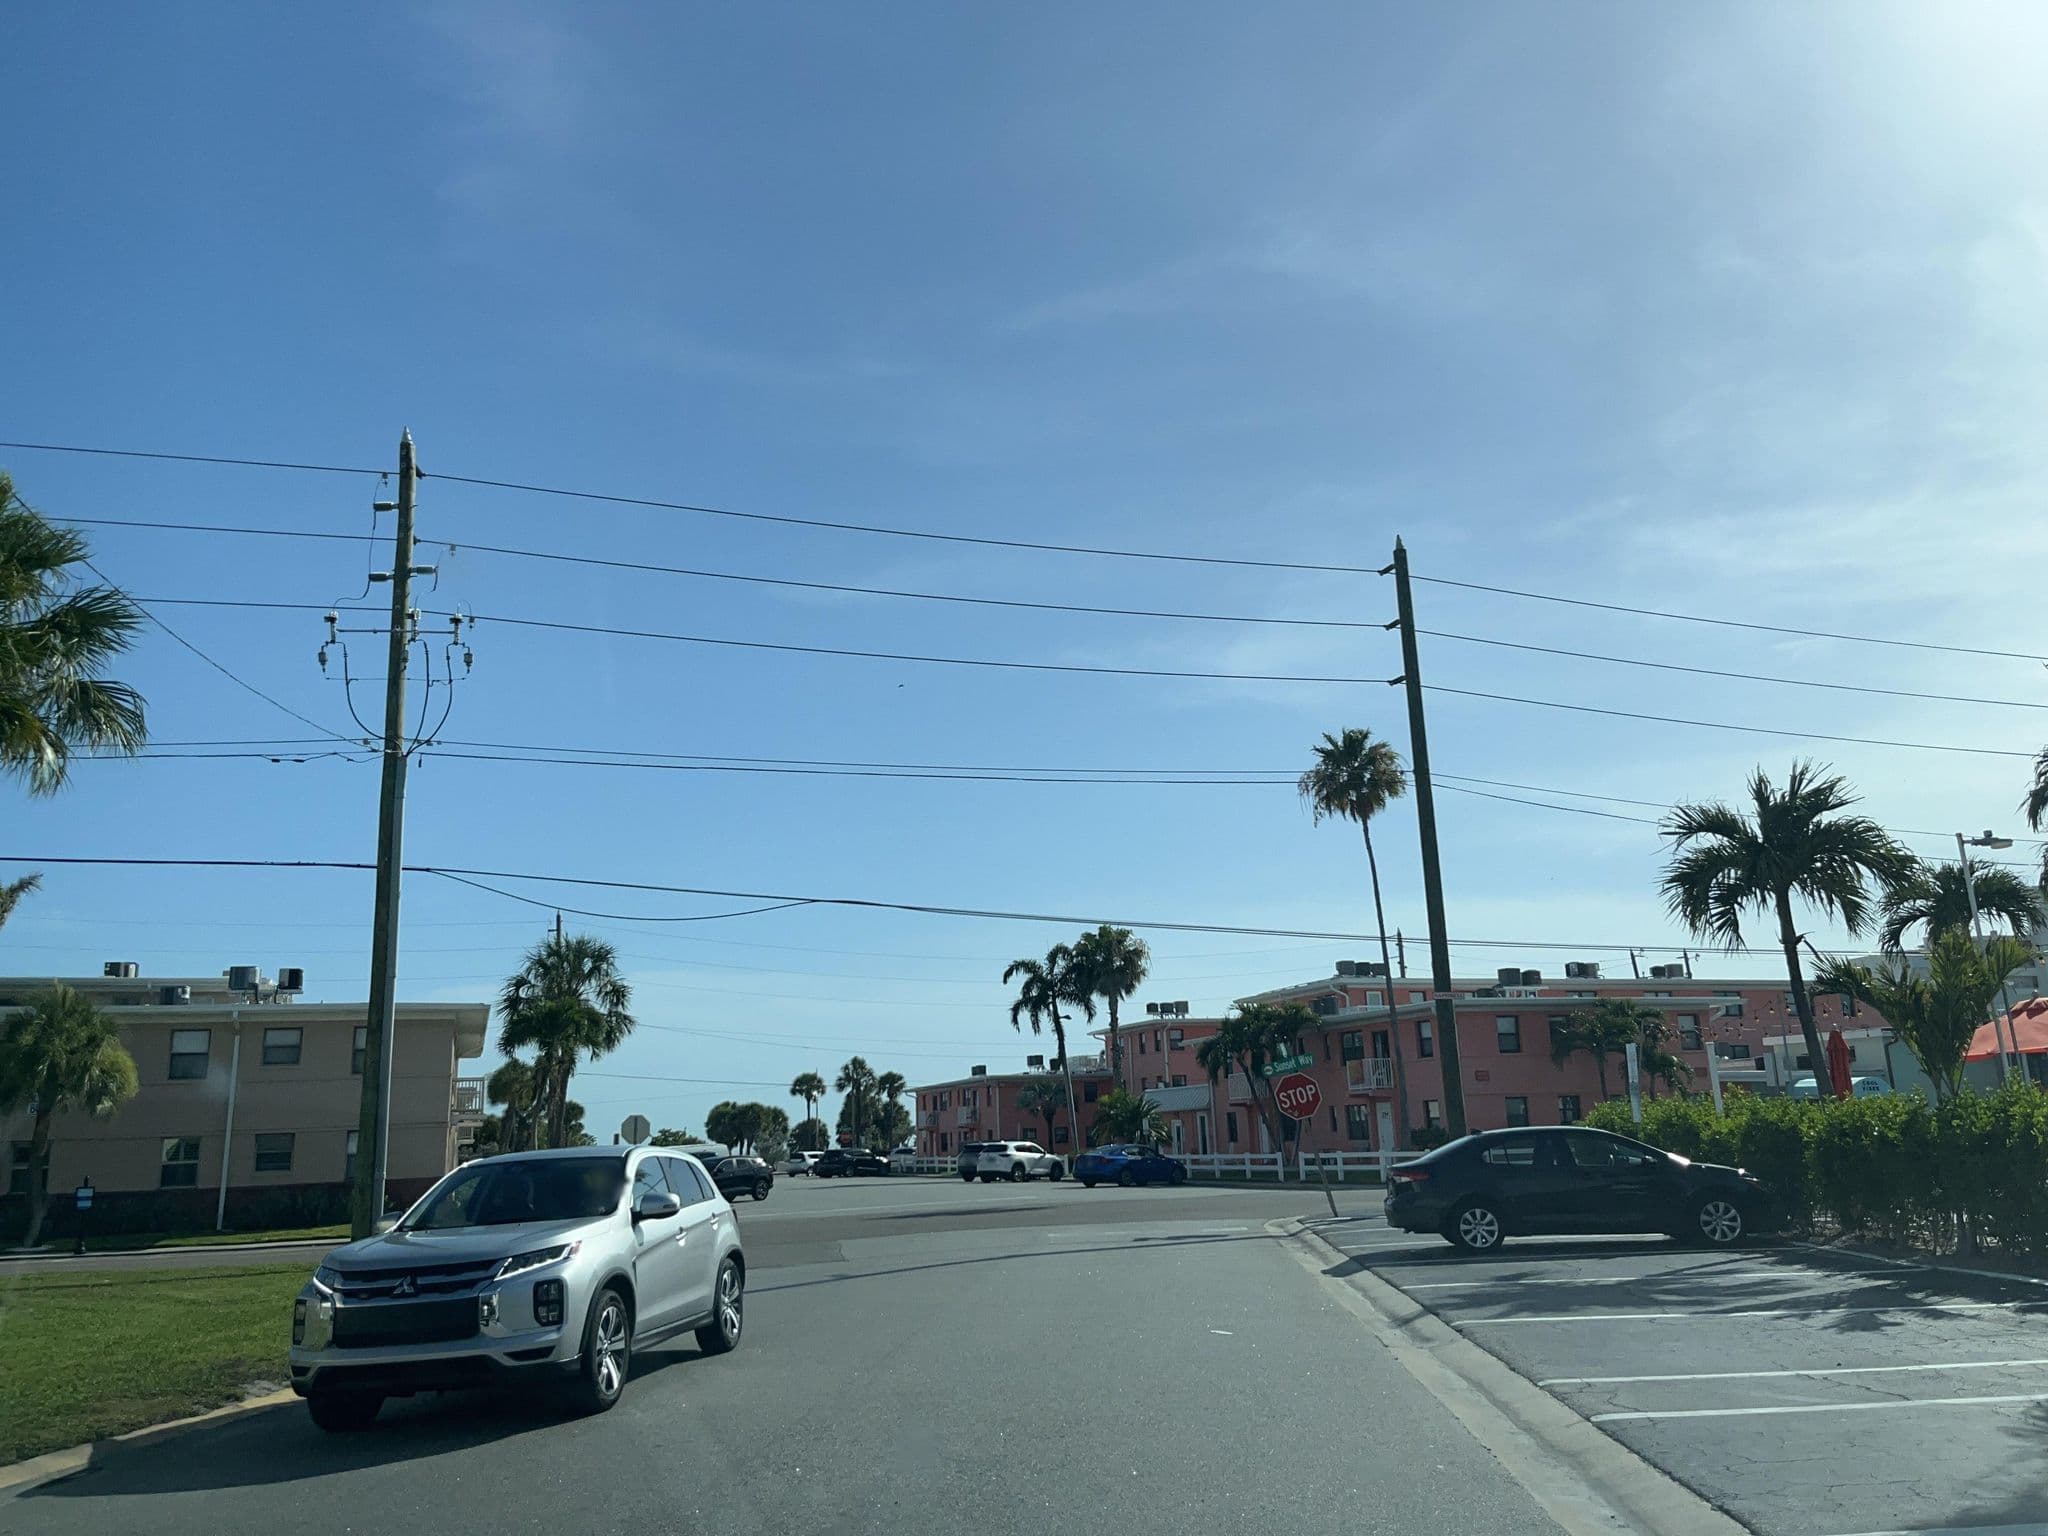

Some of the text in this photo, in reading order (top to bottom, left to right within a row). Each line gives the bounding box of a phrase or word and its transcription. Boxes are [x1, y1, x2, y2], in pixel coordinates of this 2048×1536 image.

[1274, 1055, 1313, 1072] Sunset Way
[1279, 1085, 1316, 1108] STOP
